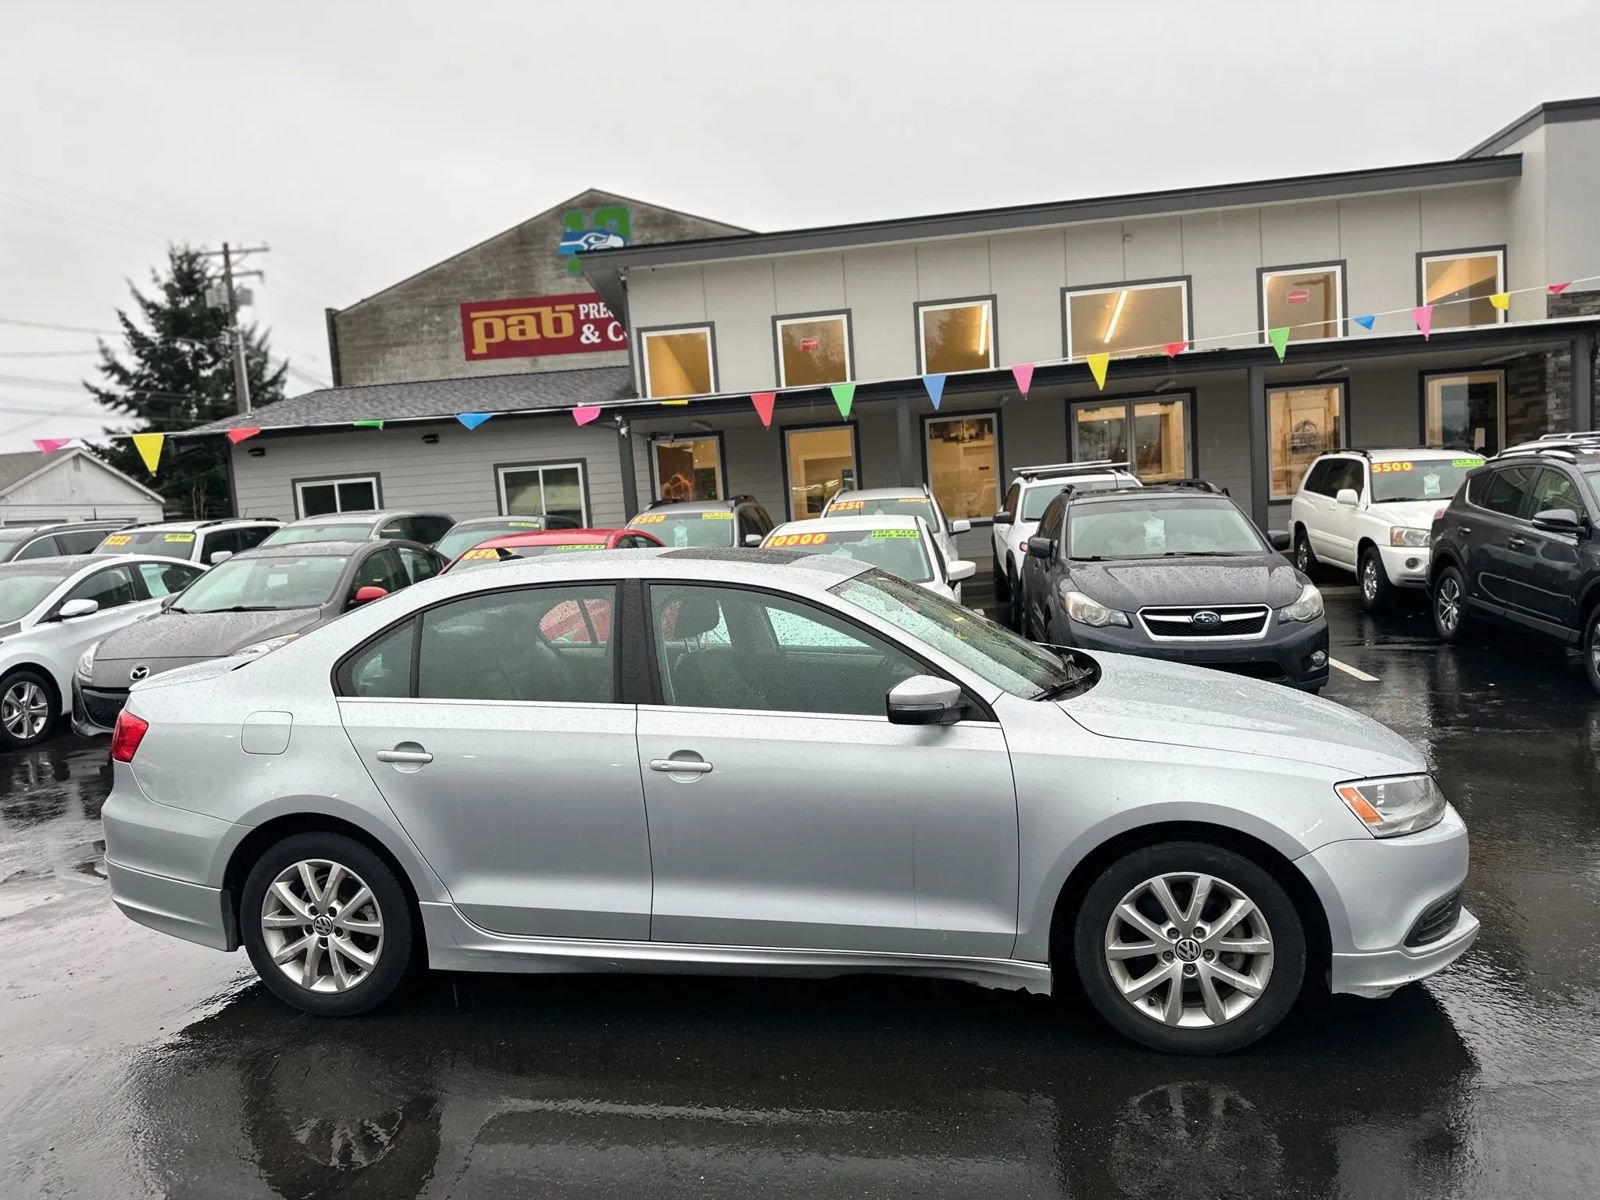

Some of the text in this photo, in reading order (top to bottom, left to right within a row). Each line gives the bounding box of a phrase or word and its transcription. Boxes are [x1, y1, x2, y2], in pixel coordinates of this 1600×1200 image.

[578, 302, 614, 320] PRE
[471, 305, 575, 354] pab
[580, 323, 602, 344] &
[1371, 462, 1413, 473] 5500
[766, 533, 827, 548] 10000
